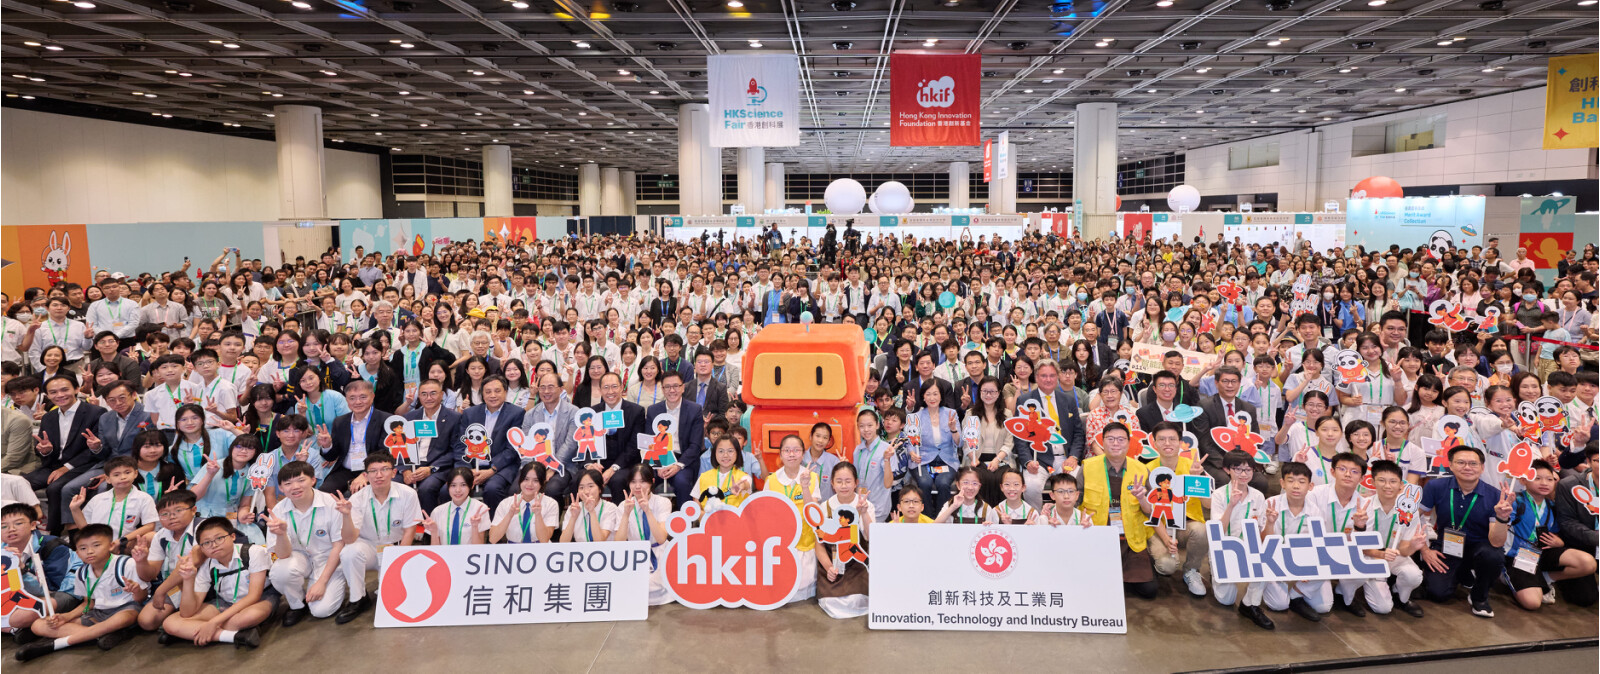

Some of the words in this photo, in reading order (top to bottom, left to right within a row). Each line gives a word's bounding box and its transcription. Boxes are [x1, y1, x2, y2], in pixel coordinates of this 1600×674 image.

[920, 87, 950, 102] hkif
[1582, 97, 1599, 109] H
[724, 109, 784, 118] HKScience
[900, 112, 918, 120] Hong
[919, 112, 937, 120] Kong
[724, 120, 746, 129] Fair
[1209, 520, 1387, 579] hkctc
[465, 552, 537, 575] SINO
[546, 550, 648, 573] GROUP
[677, 534, 782, 586] hkif
[463, 581, 612, 616] 信和集團
[928, 590, 1064, 608] 創新科技及工業局
[871, 612, 934, 624] Innovation,
[937, 613, 1003, 627] Technology
[1006, 614, 1028, 626] and
[1030, 614, 1078, 628] Industry
[1082, 616, 1124, 627] Bureau
